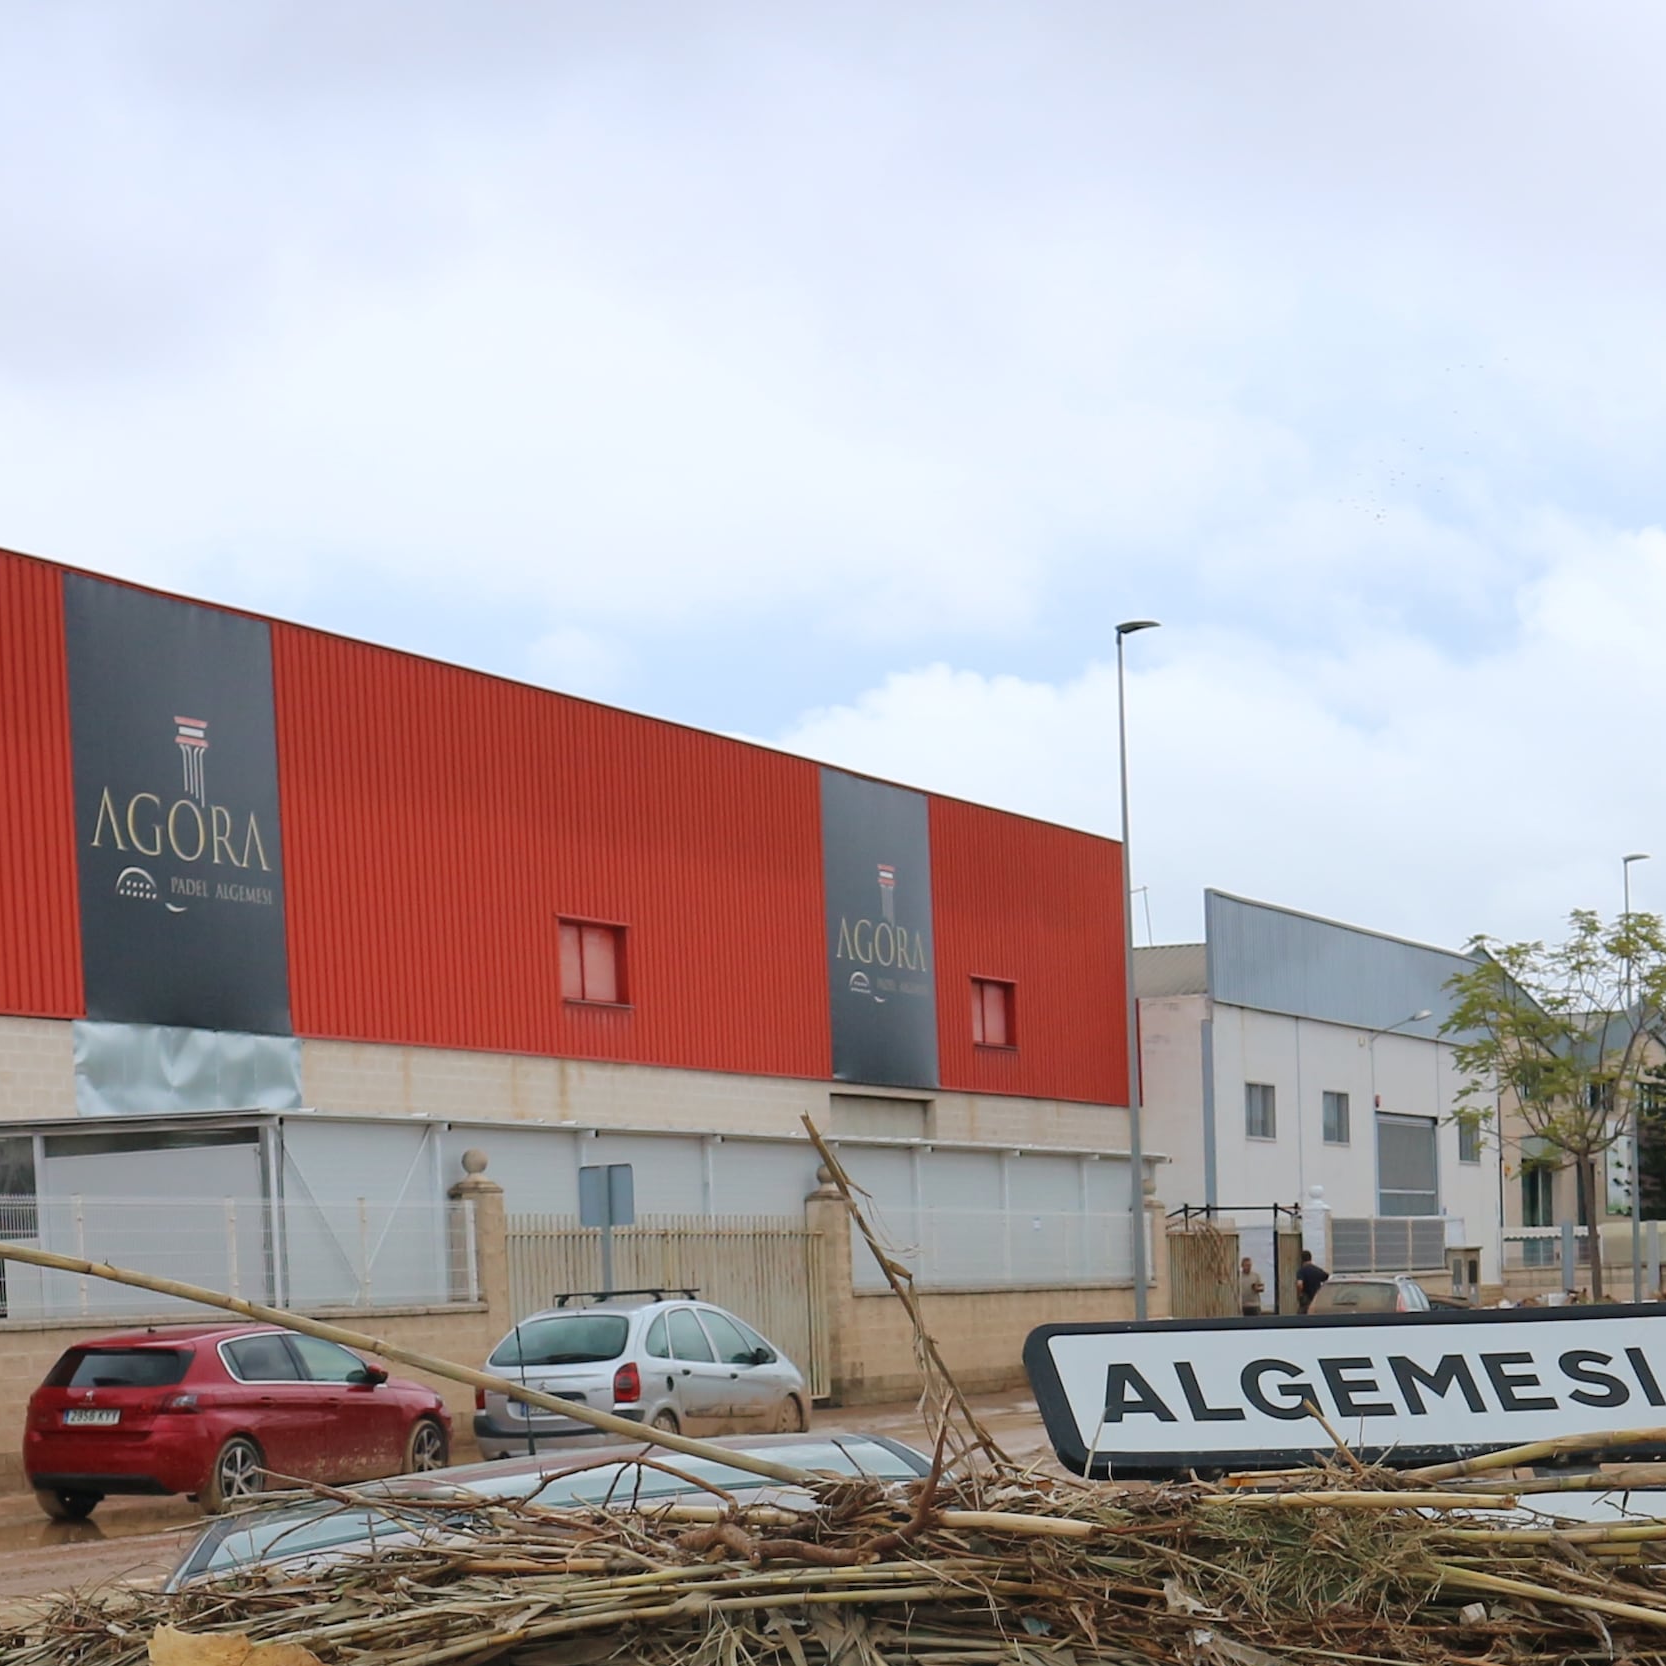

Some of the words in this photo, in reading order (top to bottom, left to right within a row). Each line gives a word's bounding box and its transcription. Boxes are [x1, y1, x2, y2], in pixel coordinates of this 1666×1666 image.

[170, 877, 208, 898] PADEL
[215, 882, 273, 905] ALGEMESI
[1103, 1347, 1666, 1423] ALGEMESI
